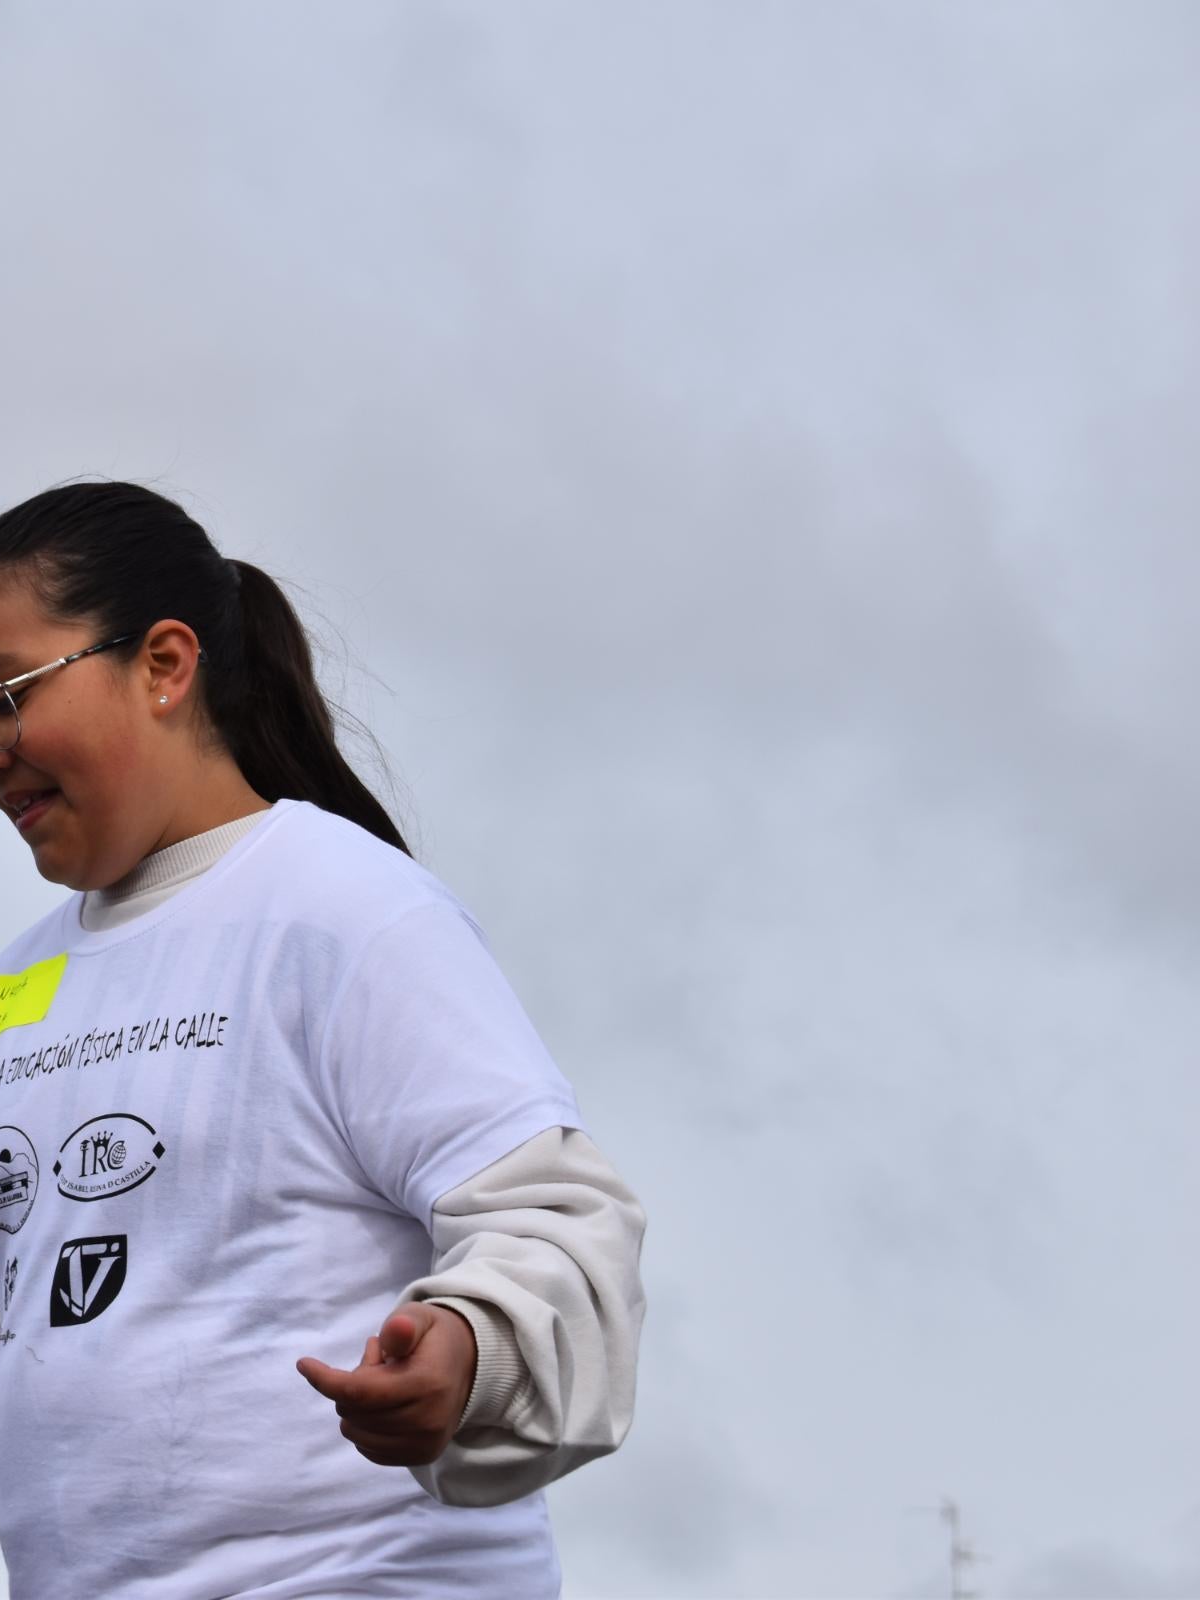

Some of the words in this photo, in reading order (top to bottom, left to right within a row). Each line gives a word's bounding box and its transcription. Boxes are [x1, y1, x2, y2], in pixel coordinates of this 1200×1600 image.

[5, 1033, 80, 1085] EDUCACIÓN
[77, 1027, 124, 1070] FÍSICA
[127, 1020, 151, 1054] EN
[148, 1017, 170, 1052] LA
[174, 1012, 229, 1050] CALLE
[113, 1160, 152, 1187] CASTILLA
